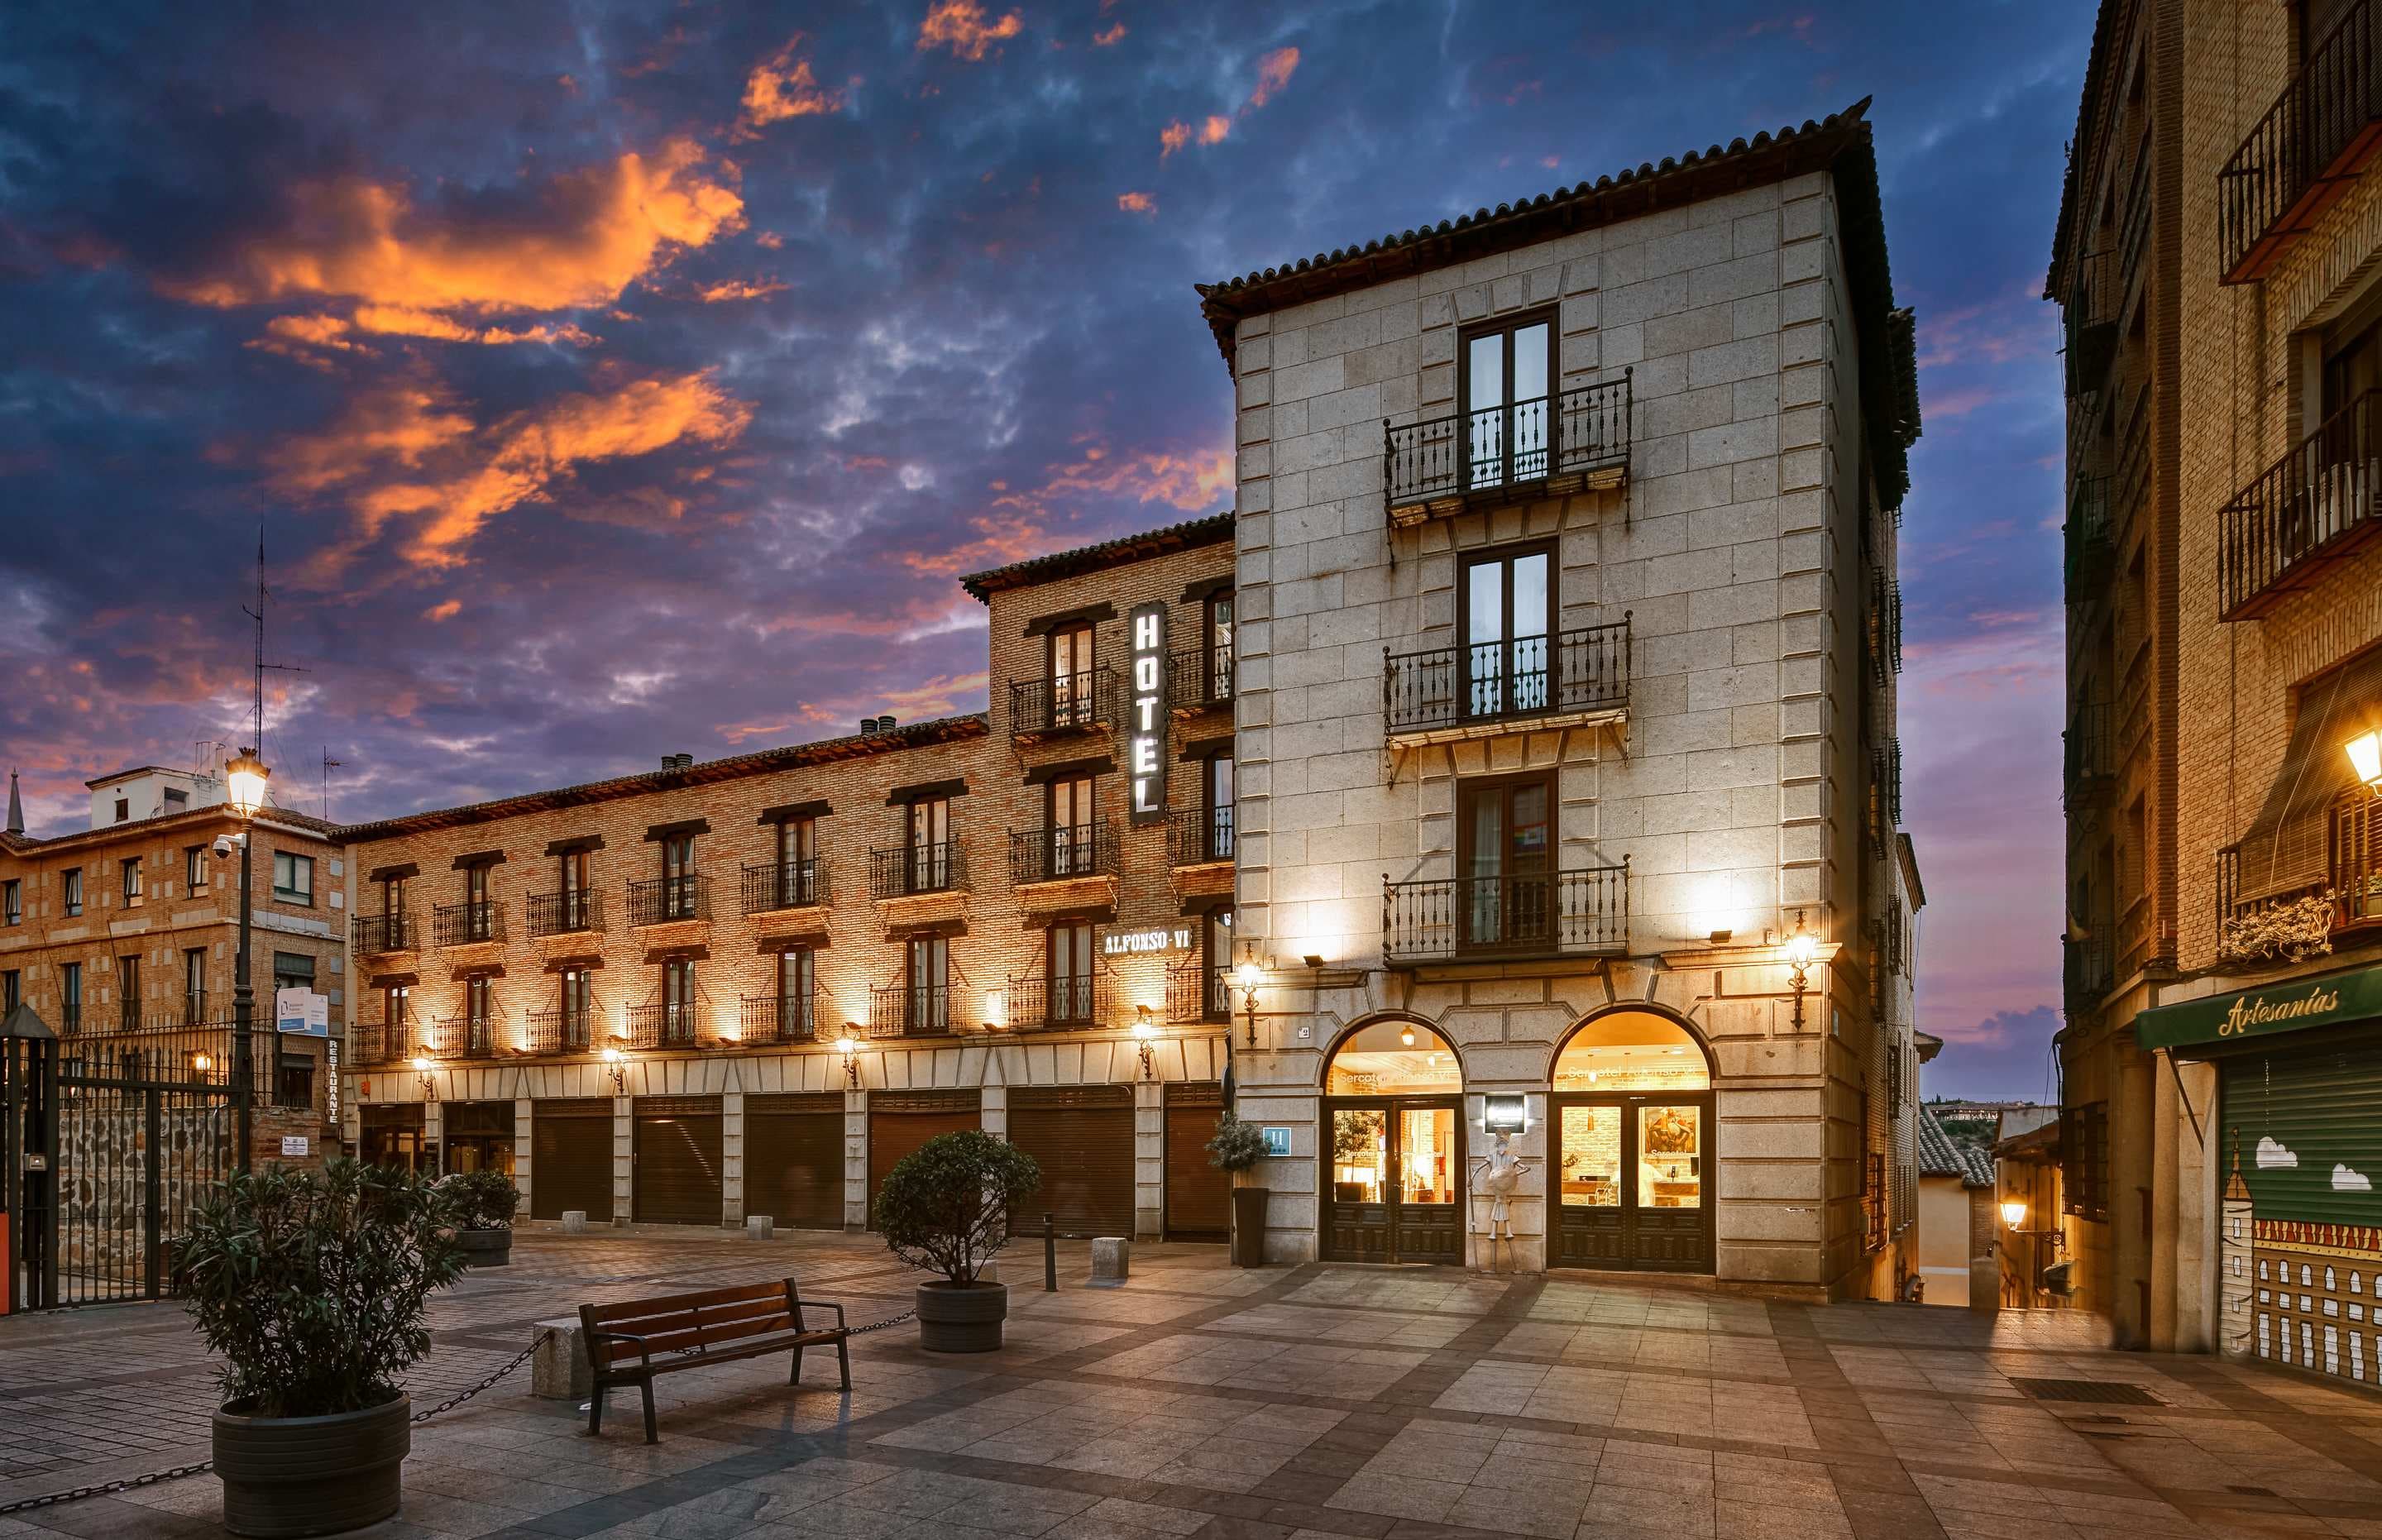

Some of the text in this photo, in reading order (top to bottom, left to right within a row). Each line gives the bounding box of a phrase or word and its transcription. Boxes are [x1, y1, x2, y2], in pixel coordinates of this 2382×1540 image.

[1136, 615, 1158, 813] HOTEL
[2218, 987, 2337, 1036] Artesanías
[329, 1040, 337, 1123] RESTAURANTE
[1271, 1131, 1283, 1145] H
